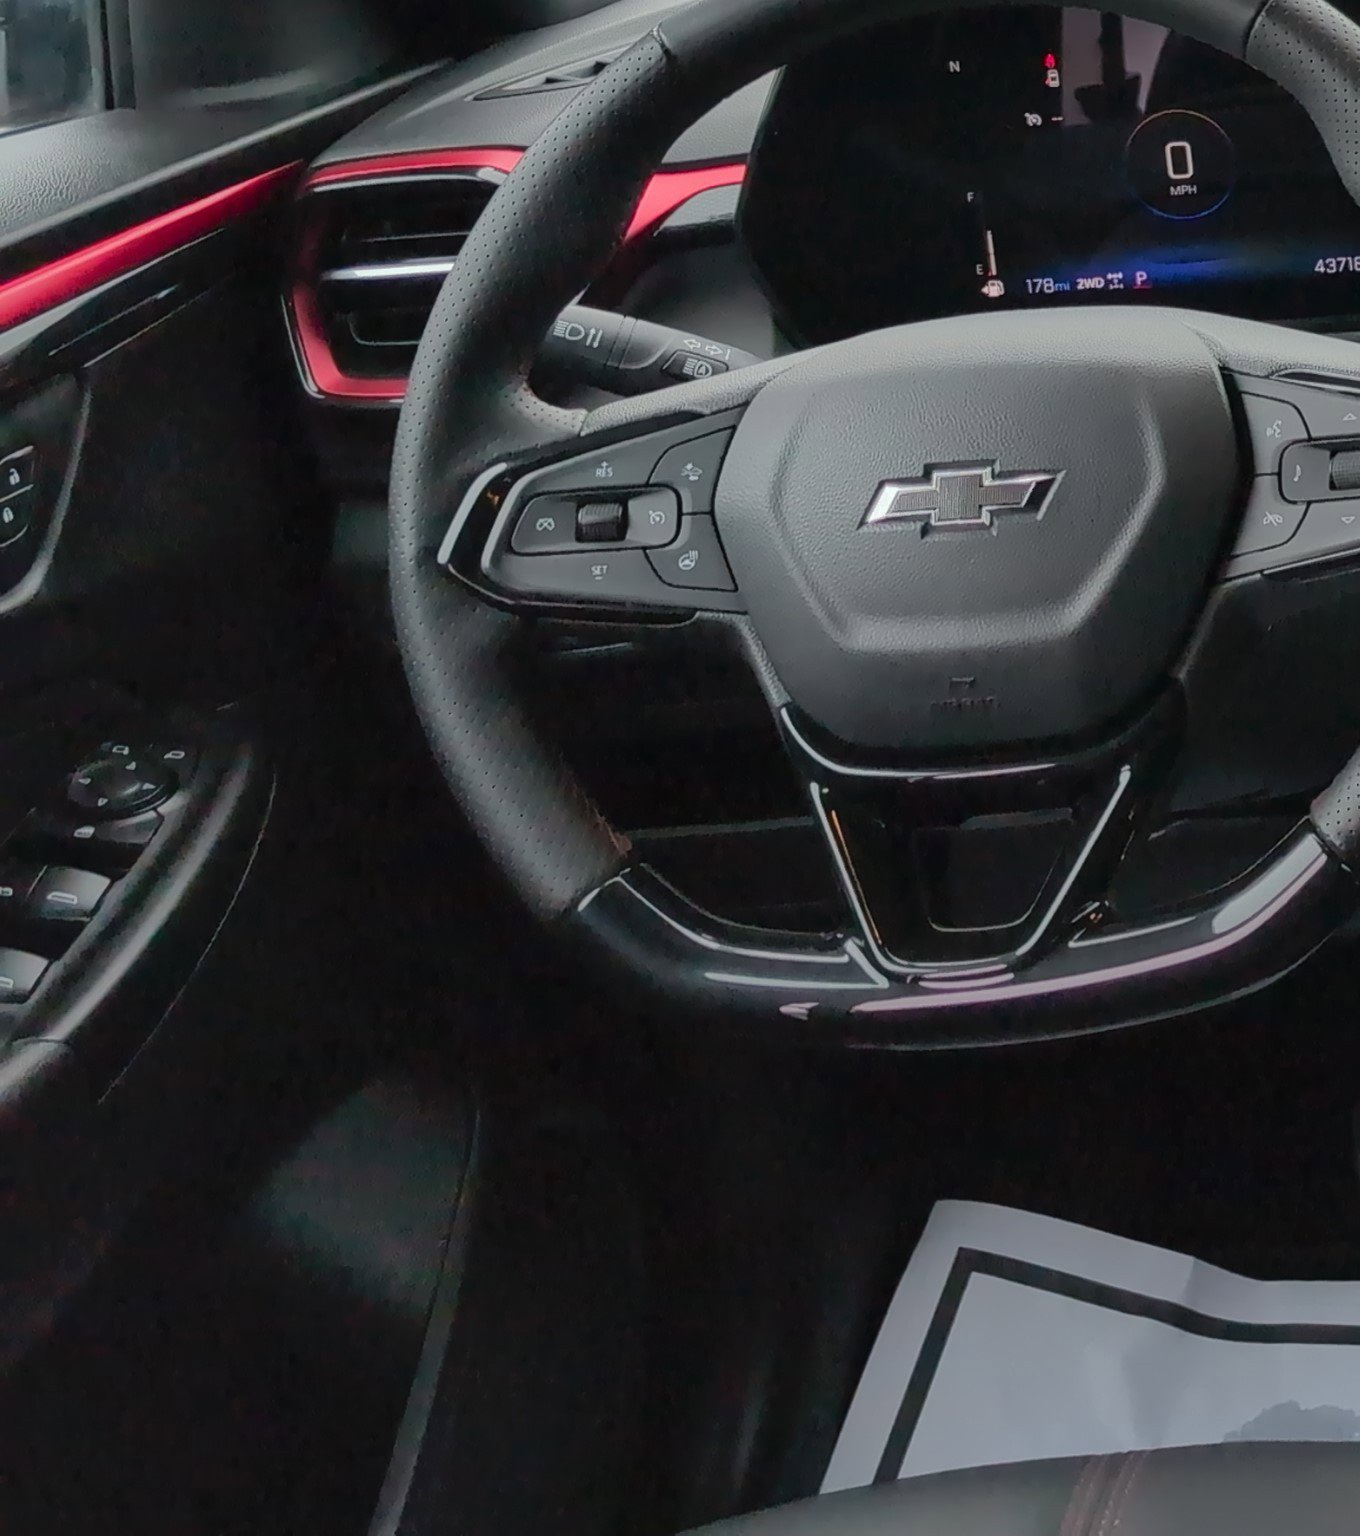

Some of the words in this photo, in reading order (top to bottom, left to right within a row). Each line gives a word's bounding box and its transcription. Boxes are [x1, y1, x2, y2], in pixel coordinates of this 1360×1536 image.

[949, 61, 960, 73] N
[1164, 141, 1194, 180] 0
[1169, 184, 1198, 196] MPH
[966, 192, 975, 203] F
[976, 264, 984, 275] E
[1076, 276, 1105, 290] 2WD
[1135, 271, 1148, 284] P
[590, 564, 609, 576] SET
